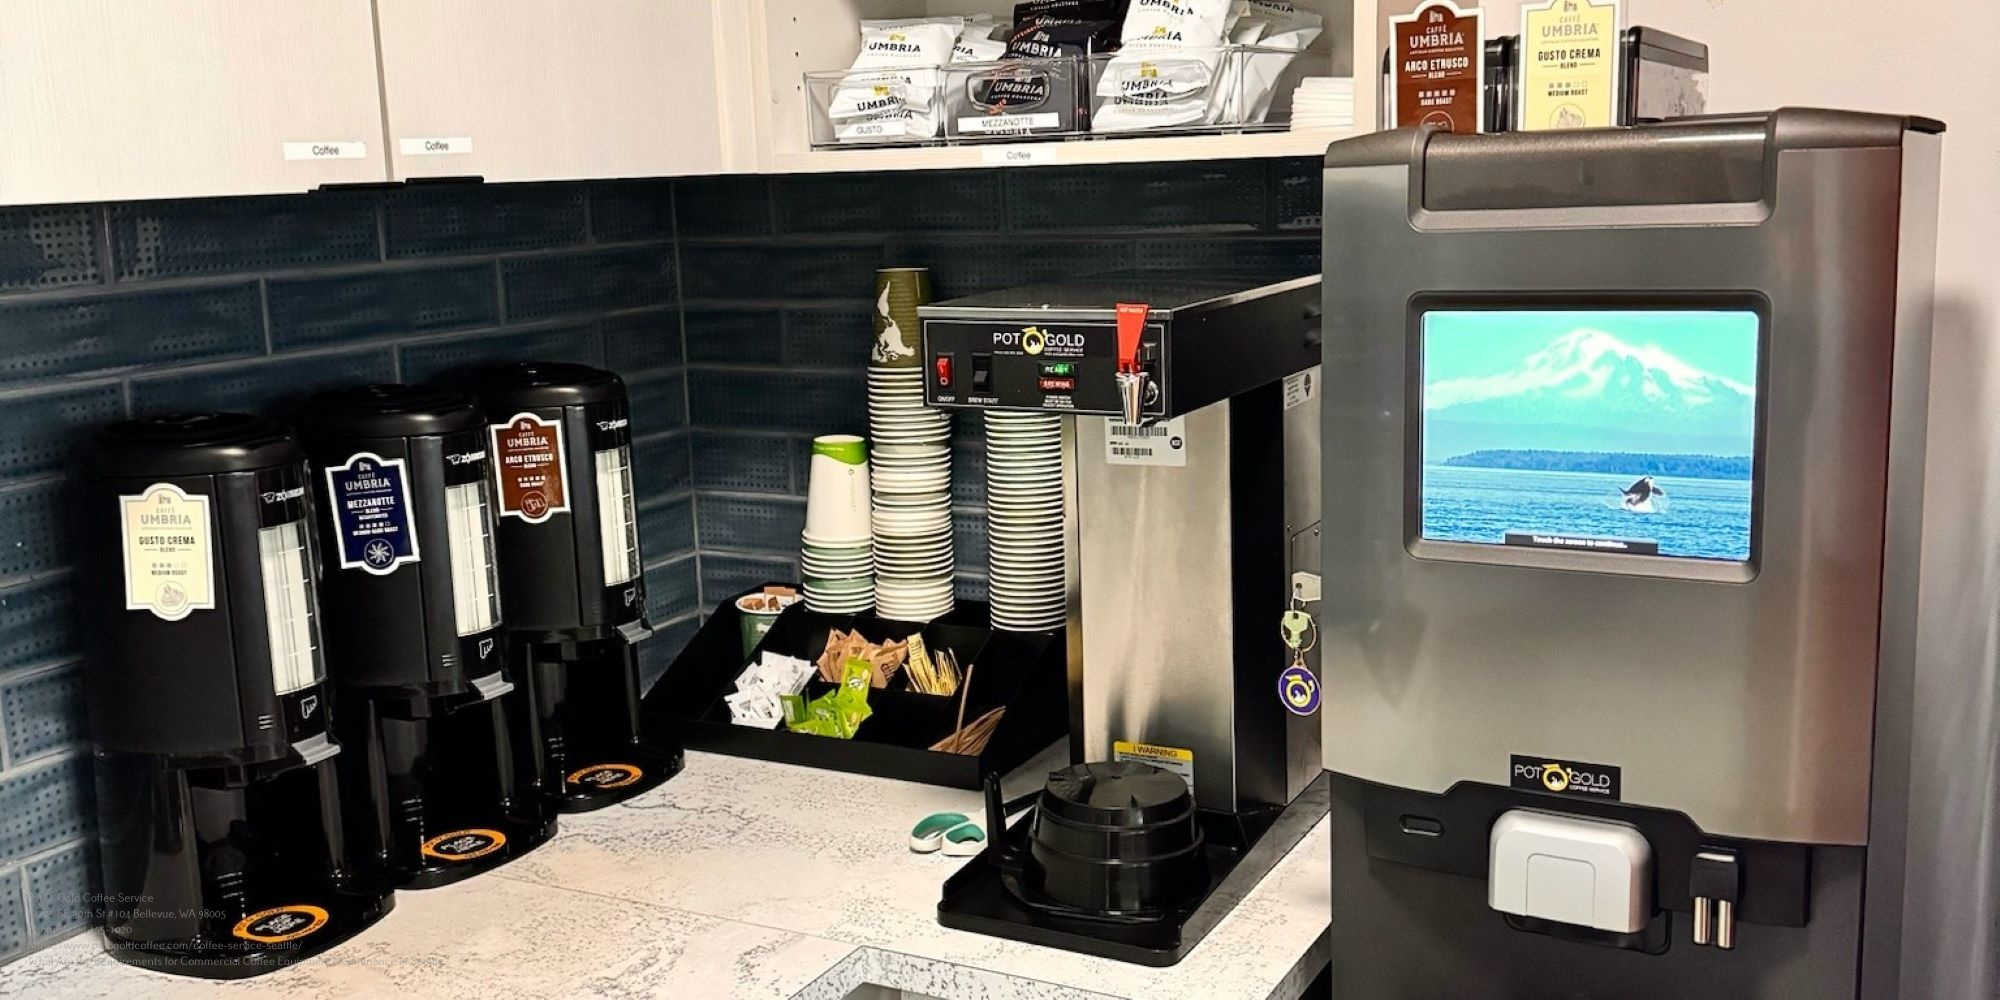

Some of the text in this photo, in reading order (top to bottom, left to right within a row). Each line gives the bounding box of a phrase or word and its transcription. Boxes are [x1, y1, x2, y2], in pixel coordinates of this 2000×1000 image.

[1542, 23, 1599, 38] UMBRIA
[1410, 32, 1464, 48] UMBRIA
[868, 42, 921, 53] UMBRIA
[1012, 42, 1062, 58] UMBRIA
[1538, 47, 1601, 61] GUSTO CREMA
[1405, 56, 1469, 71] ARCO ETRUSCO
[994, 81, 1044, 96] UMBRIA
[982, 117, 1035, 128] MEZZANOTTE
[856, 126, 883, 135] GUSTO
[312, 145, 340, 156] Coffee
[425, 141, 450, 151] Coffee
[1006, 150, 1032, 160] Coffee
[992, 332, 1021, 346] POT
[1045, 333, 1085, 347] GOLD
[507, 436, 549, 448] UMBRIA
[505, 453, 553, 464] ARCO ETRUSCO
[345, 478, 391, 491] UMBRIA
[347, 496, 396, 510] MEZZANOTTE
[140, 514, 191, 525] UMBRIA
[138, 535, 195, 545] GUSTO CREMA
[1532, 535, 1552, 544] Touch
[1553, 536, 1564, 545] the
[1137, 745, 1178, 758] WARNING
[1514, 764, 1542, 780] POT
[1568, 771, 1611, 788] GOLD
